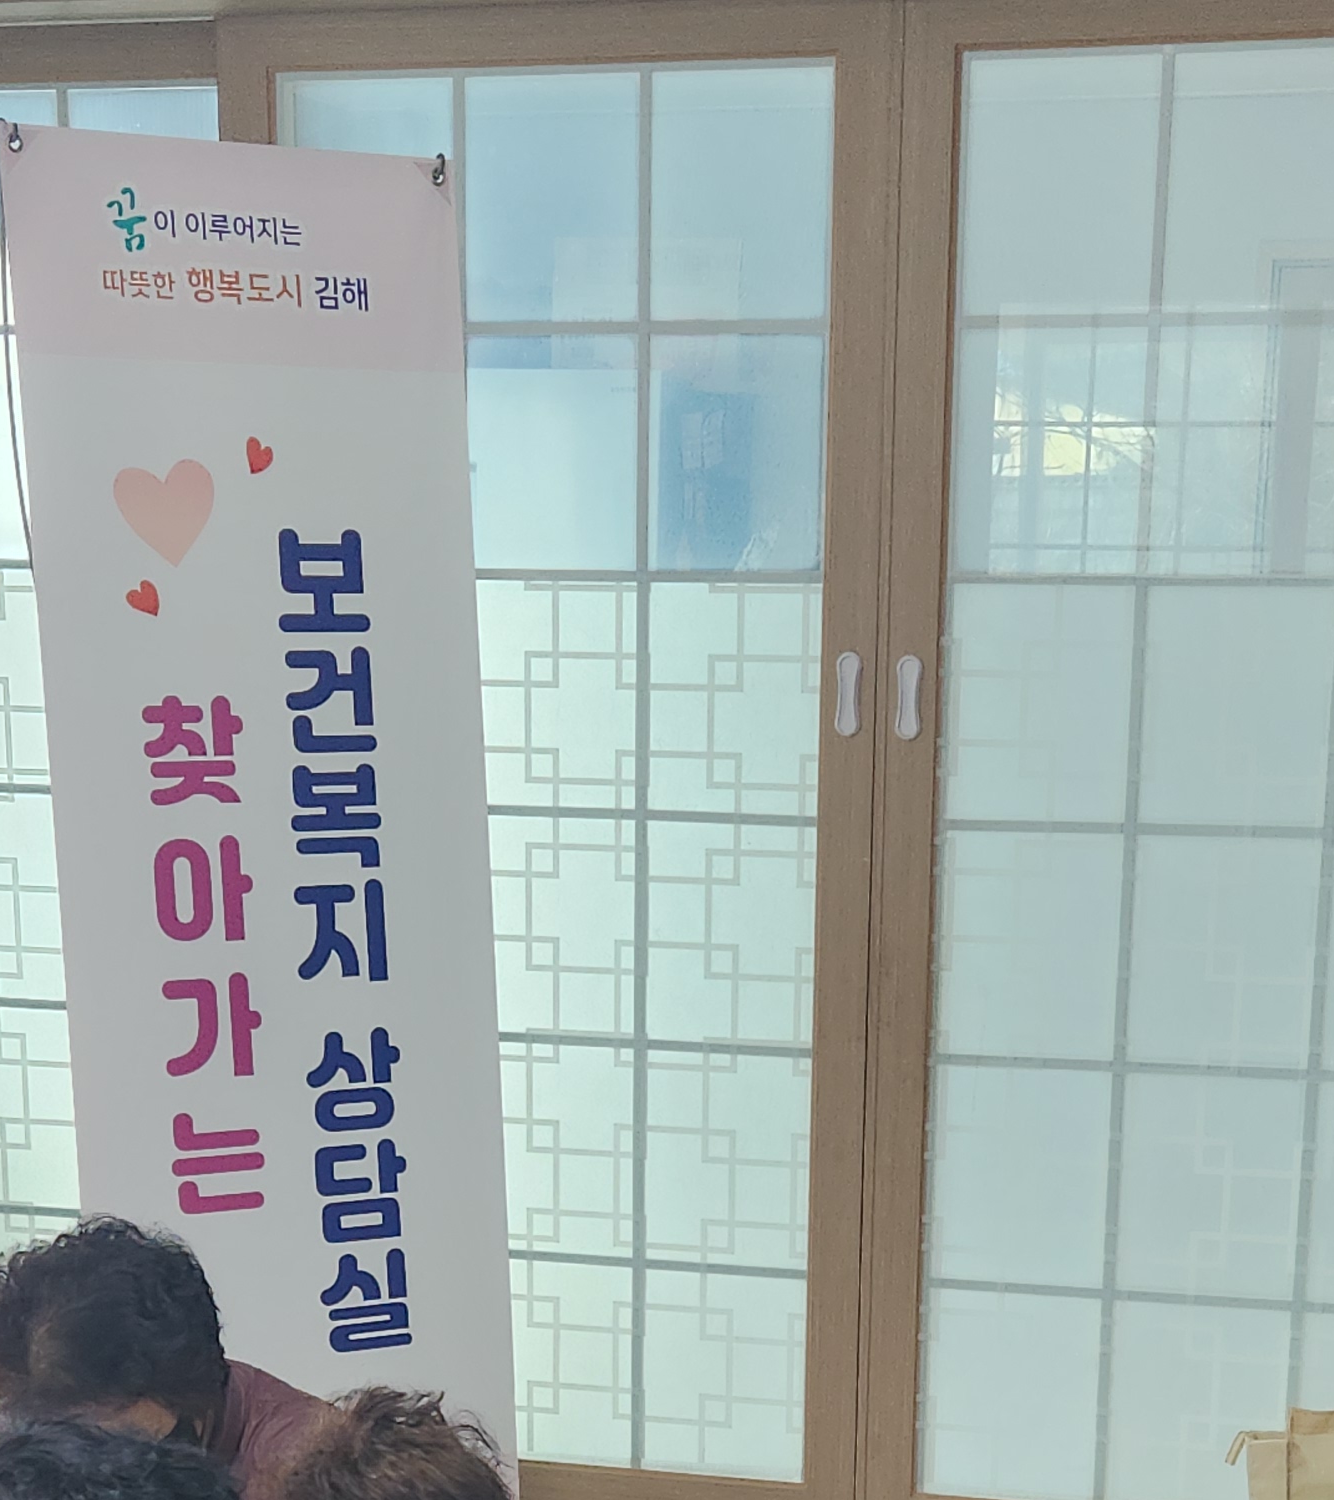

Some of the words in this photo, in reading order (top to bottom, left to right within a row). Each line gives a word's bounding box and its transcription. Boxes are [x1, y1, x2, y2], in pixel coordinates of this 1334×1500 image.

[102, 269, 176, 300] 따뜻한
[185, 267, 303, 308] 행복도시
[314, 276, 369, 312] 김해
[185, 211, 302, 246] 이루어지는
[278, 528, 389, 982] 보건복지
[141, 695, 266, 1214] 찾아가는
[305, 1026, 413, 1353] 상담실
